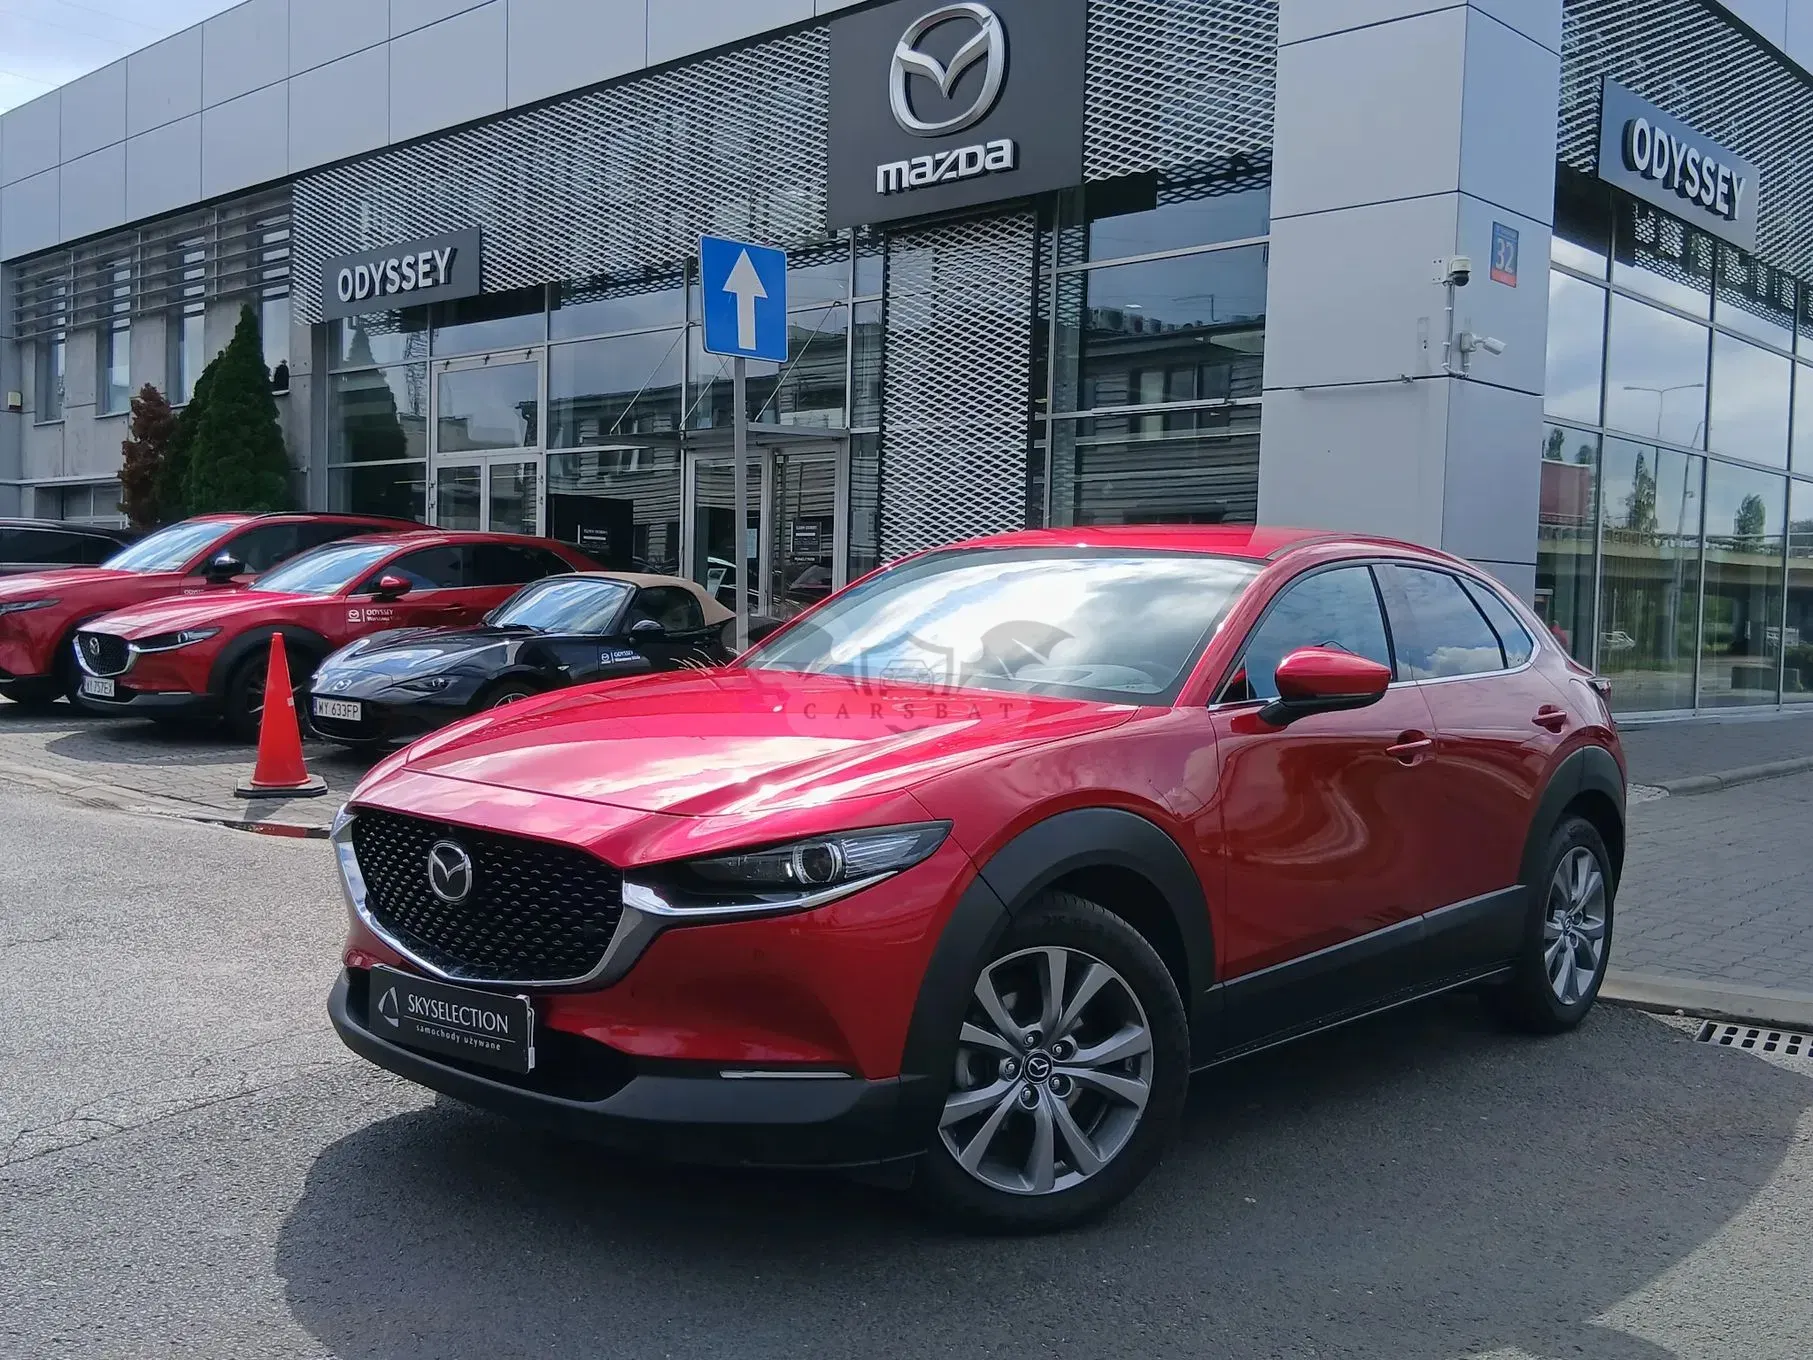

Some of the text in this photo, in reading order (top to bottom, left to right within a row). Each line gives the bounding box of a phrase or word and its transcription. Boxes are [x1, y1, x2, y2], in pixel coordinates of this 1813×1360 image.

[876, 138, 1014, 194] mazda
[1631, 117, 1747, 220] ODYSSEY
[337, 246, 453, 302] ODYSSEY
[1495, 237, 1515, 274] 32
[366, 608, 394, 616] ODYSSEY
[318, 700, 359, 719] WY 633FP
[408, 993, 509, 1034] SKYSELECTION
[415, 1024, 501, 1051] samochody używane
